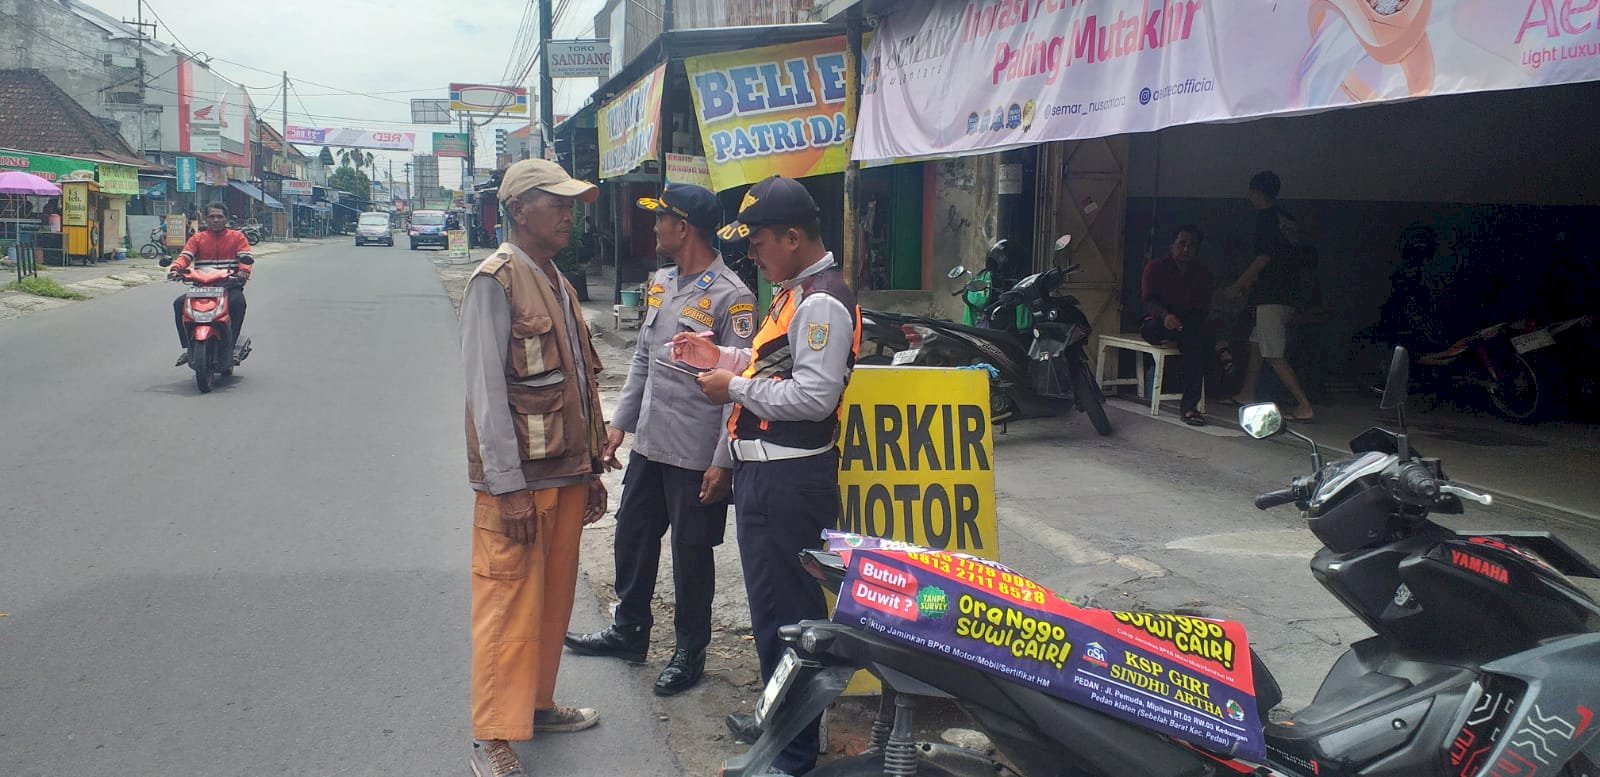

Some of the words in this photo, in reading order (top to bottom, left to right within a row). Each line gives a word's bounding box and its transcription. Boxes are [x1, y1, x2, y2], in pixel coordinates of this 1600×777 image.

[1512, 0, 1600, 44] Ae
[552, 53, 610, 65] SANDANG
[992, 33, 1064, 86] Paling
[1522, 46, 1558, 68] Light
[694, 59, 814, 122] BELI
[711, 118, 808, 161] PATRI
[838, 404, 991, 471] ARKIR
[863, 563, 907, 588] Butuh
[1451, 549, 1509, 584] YAMAHA
[857, 583, 901, 611] Duwit
[904, 598, 913, 612] ?
[920, 601, 948, 611] SURVEY
[922, 593, 946, 603] TANPA
[998, 581, 1046, 605] 8528
[887, 626, 926, 645] Jaminkan
[927, 639, 951, 653] BPKB
[952, 647, 1035, 682] Motor/Mobil/Sertifikat
[1036, 676, 1051, 688] HM
[1011, 640, 1073, 669] CAIR!
[1087, 648, 1105, 662] GSA
[1175, 632, 1233, 669] CAIR!
[1110, 664, 1170, 697] SINDHU
[1174, 690, 1225, 719] ARTHA
[1124, 650, 1164, 677] KSP
[1168, 670, 1210, 699] GIRI
[1074, 675, 1100, 690] PEDAN
[1115, 689, 1145, 707] Pemuda,
[1146, 700, 1172, 716] Mipitan
[1173, 710, 1192, 722] RT.02
[1091, 692, 1113, 706] Pedan
[1114, 700, 1136, 714] klaten
[1137, 708, 1168, 725] (Sebelah
[1169, 719, 1188, 731] Barat
[1189, 725, 1204, 737] Kec.
[1205, 730, 1230, 746] Pedan)
